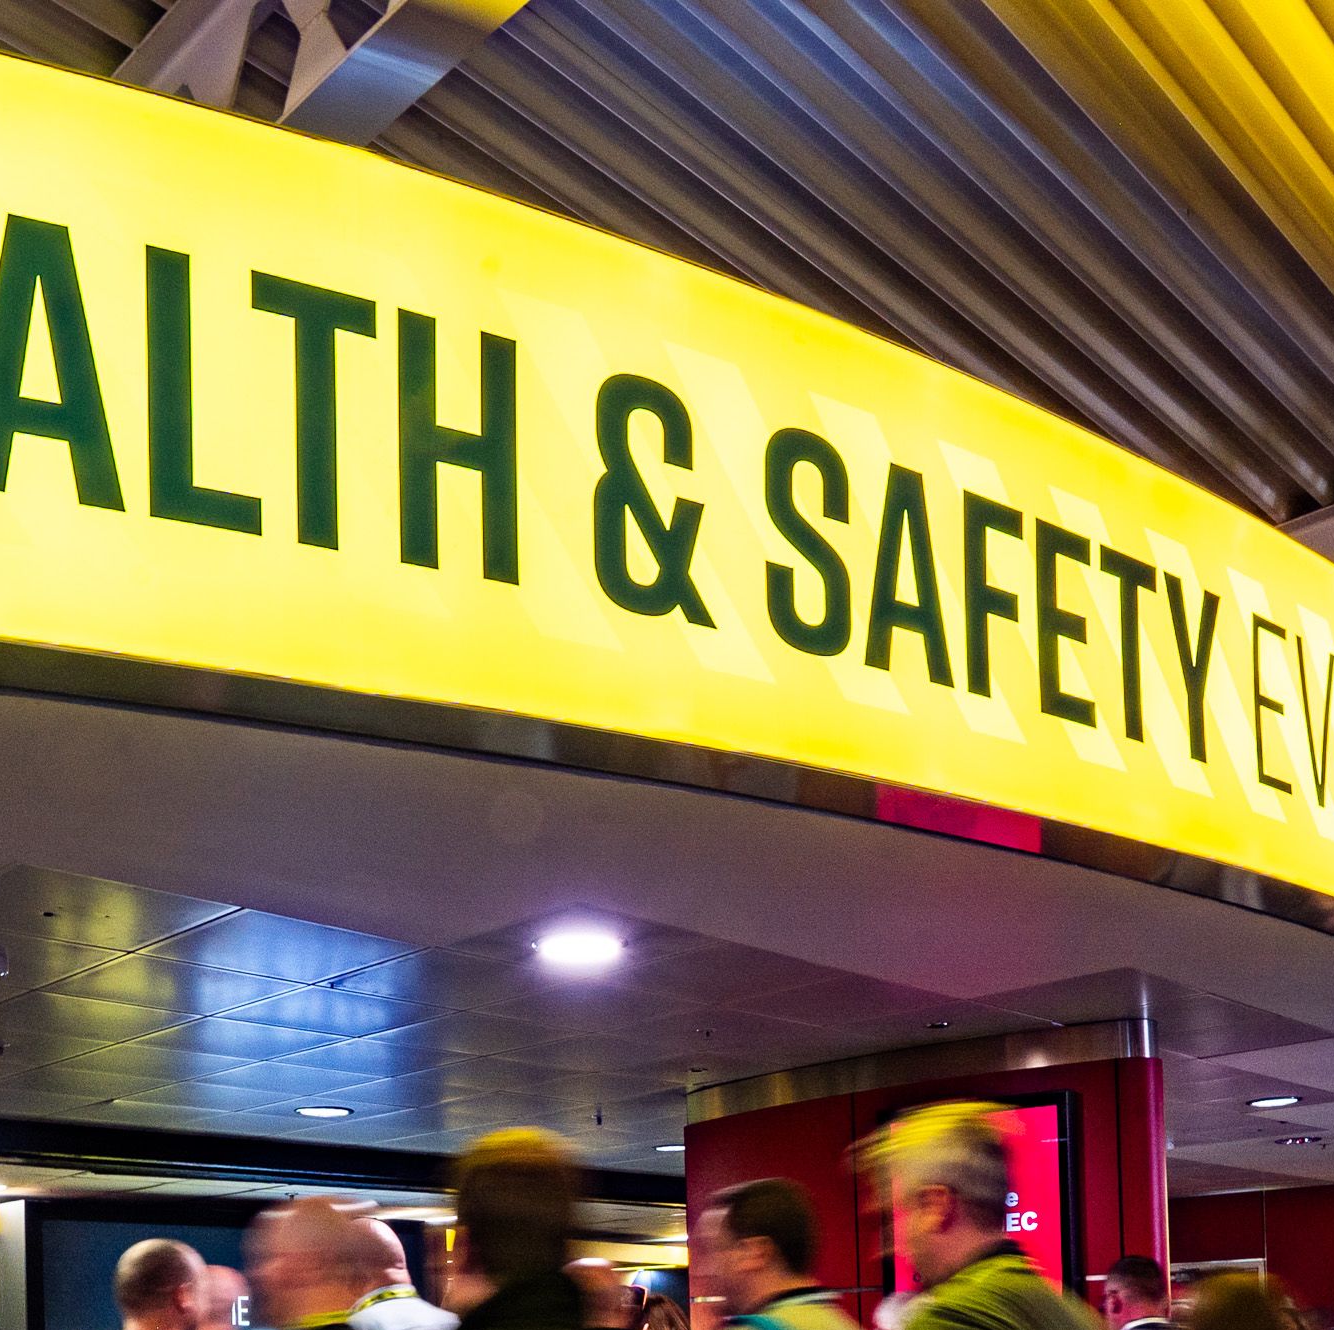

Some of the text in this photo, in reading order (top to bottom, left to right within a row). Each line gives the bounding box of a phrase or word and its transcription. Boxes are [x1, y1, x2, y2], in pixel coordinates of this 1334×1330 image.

[593, 373, 718, 630] &
[765, 427, 1221, 764] SAFETY
[1005, 1211, 1038, 1232] EC
